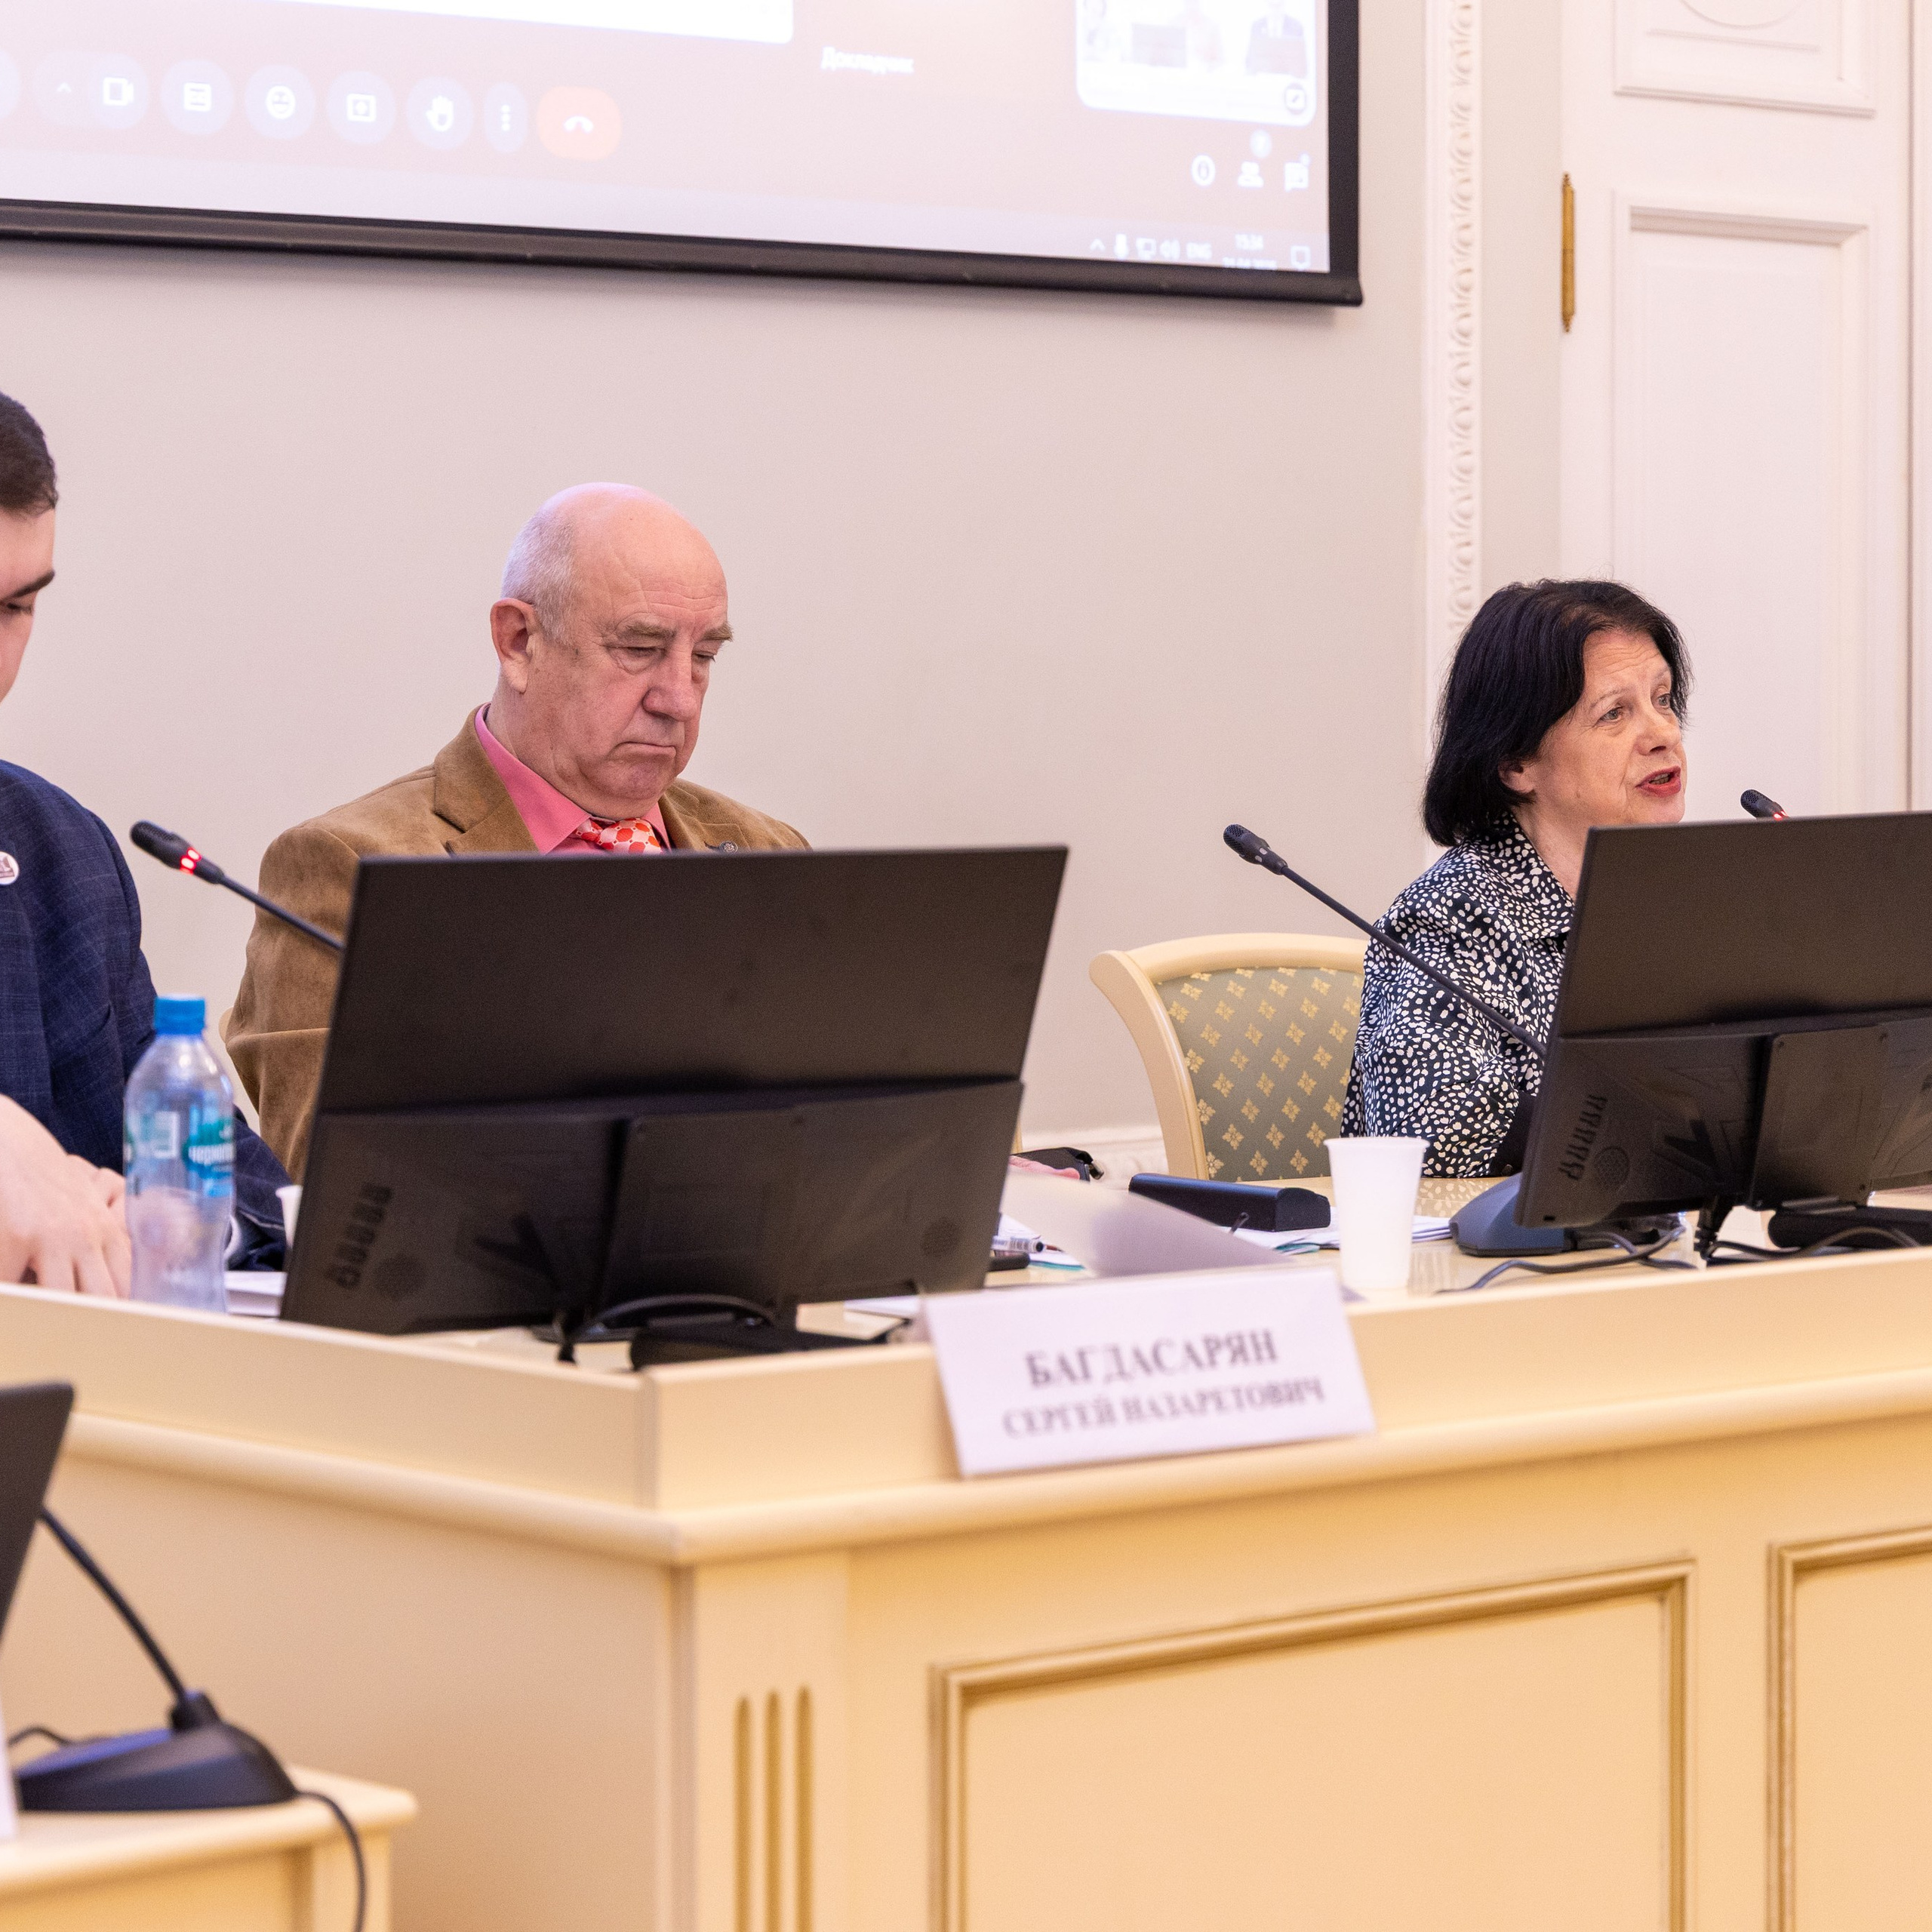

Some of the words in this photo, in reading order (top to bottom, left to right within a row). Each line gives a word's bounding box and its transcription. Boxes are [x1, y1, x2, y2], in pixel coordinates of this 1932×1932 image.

[1026, 1328, 1278, 1388] БАГДАСАРЯН
[1001, 1395, 1116, 1439] СЕРГЕЙ
[1121, 1375, 1325, 1424] НАЗАРЕТОВИЧ
